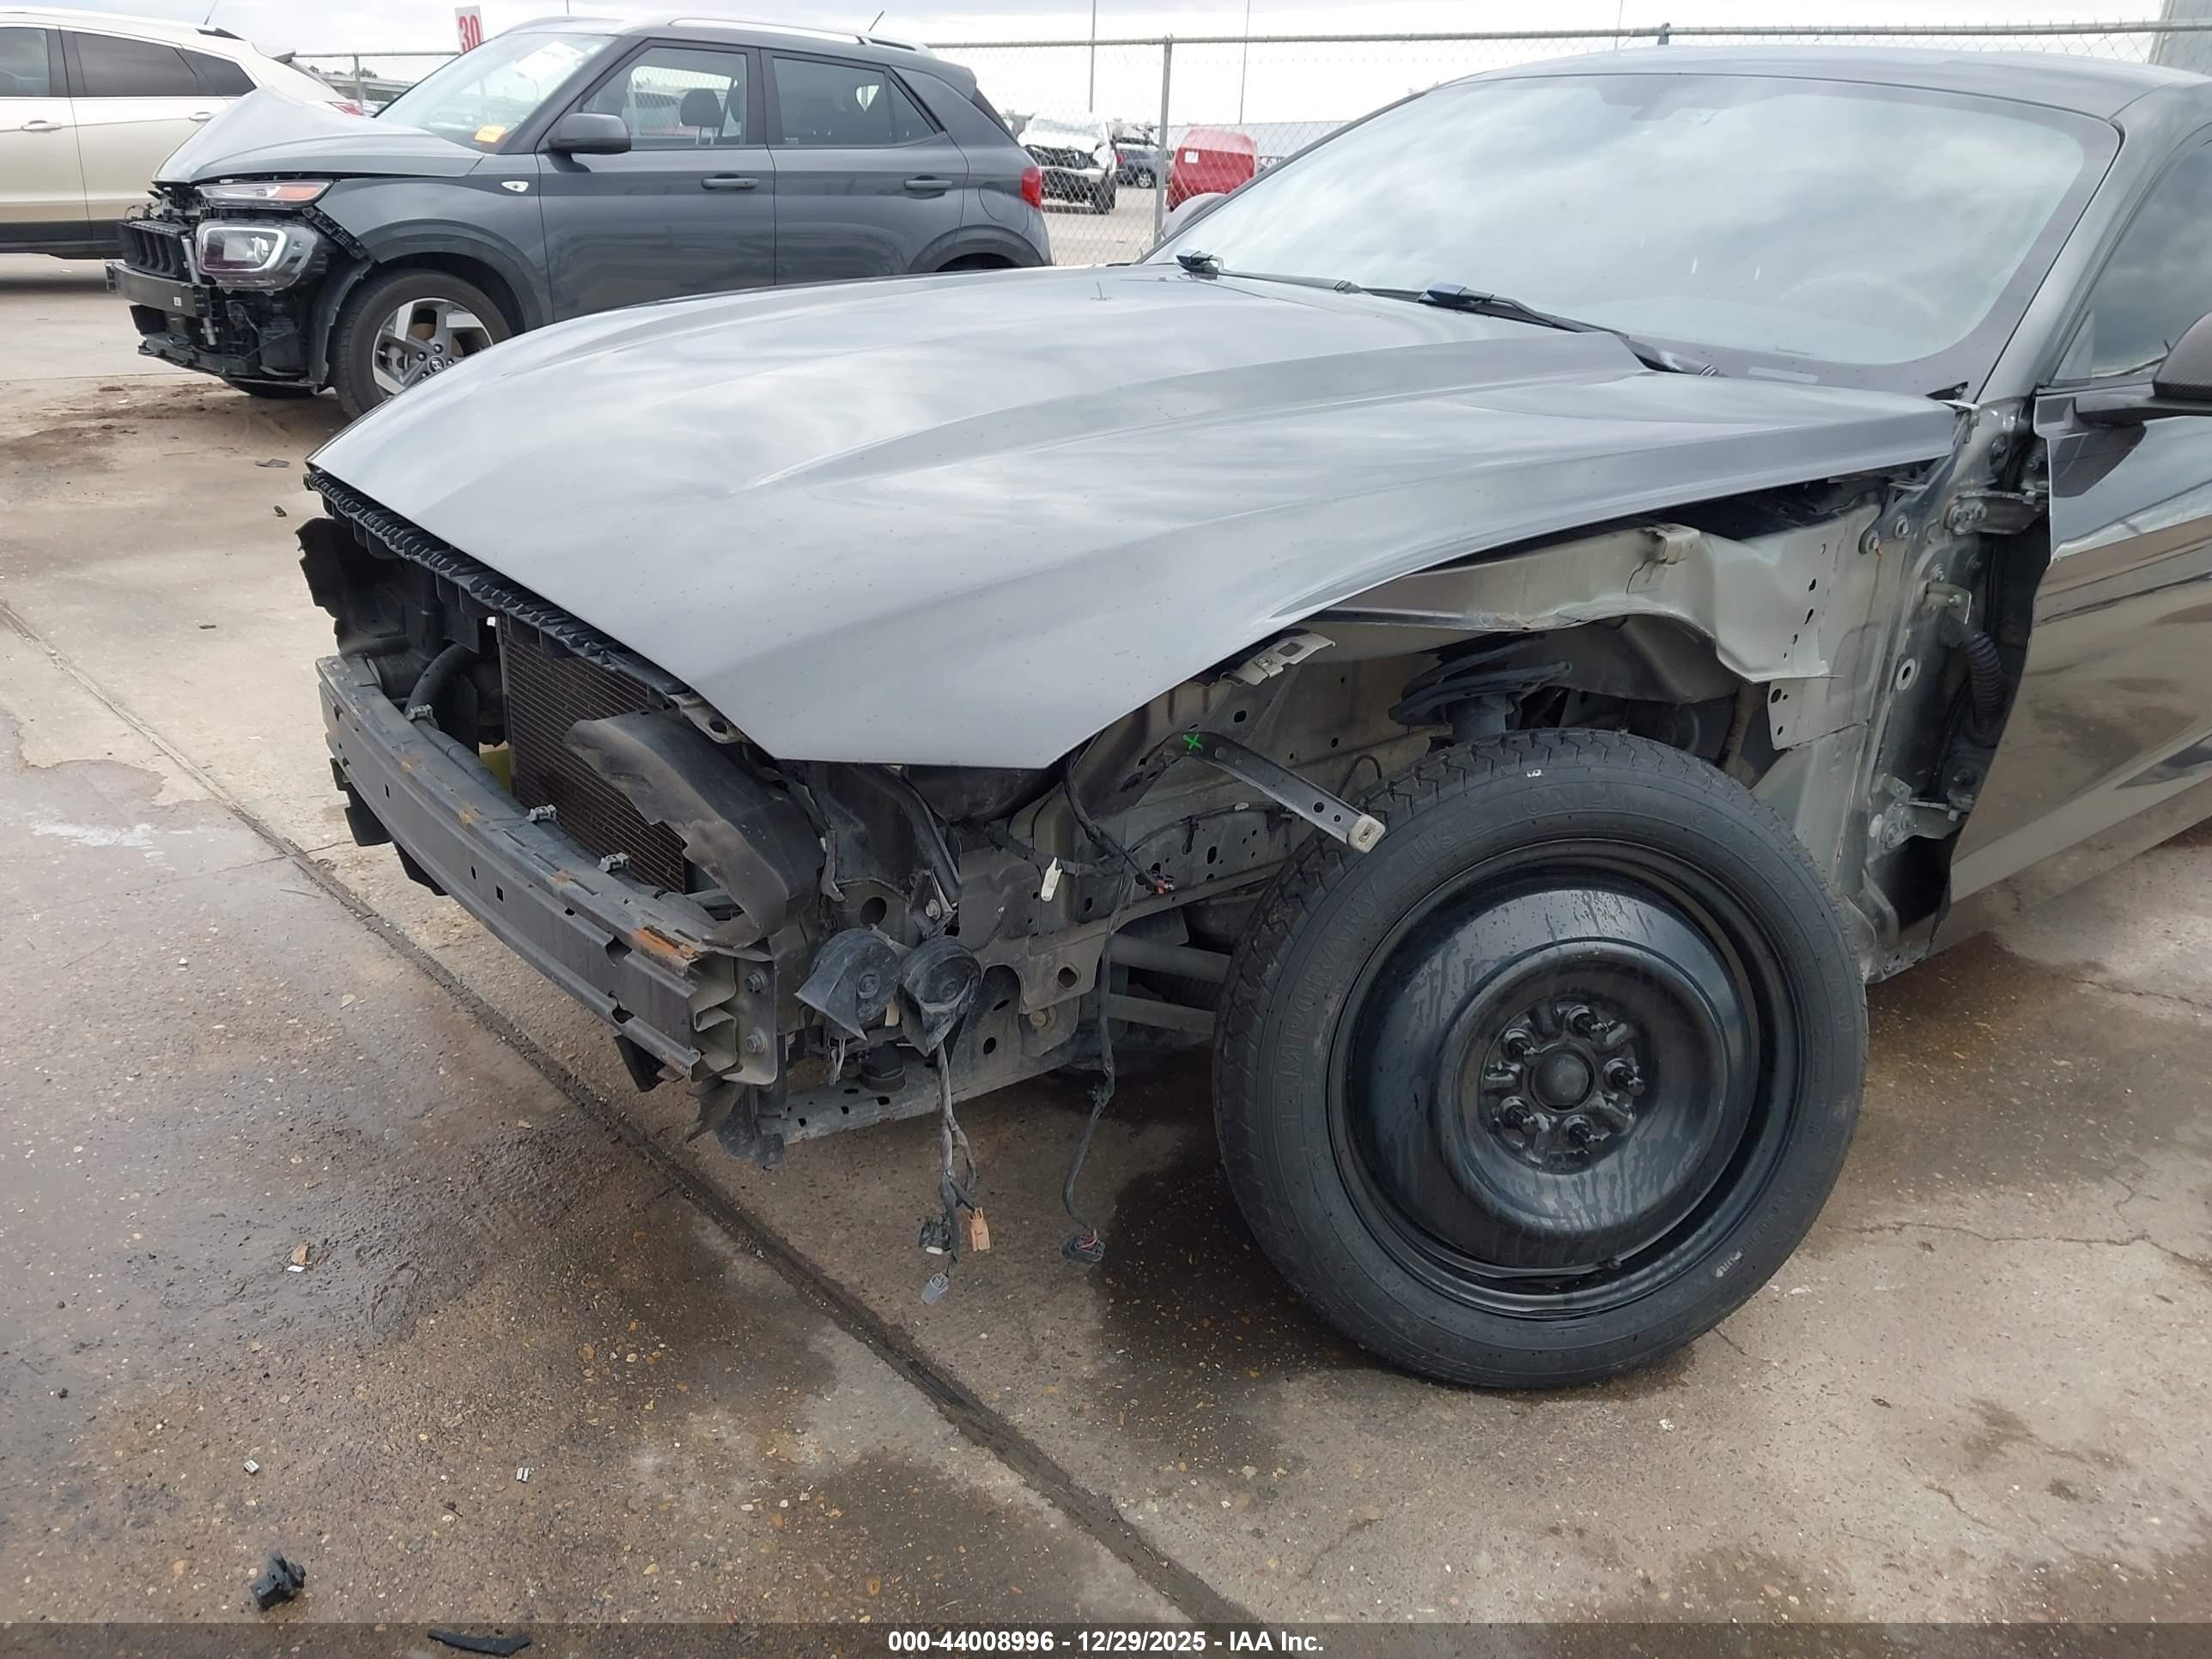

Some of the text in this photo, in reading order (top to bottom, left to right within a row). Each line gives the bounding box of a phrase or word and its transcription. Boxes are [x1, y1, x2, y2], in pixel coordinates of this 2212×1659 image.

[459, 14, 482, 52] 30
[1278, 883, 1382, 1133] TEMPORARY
[1407, 811, 1486, 865] USE
